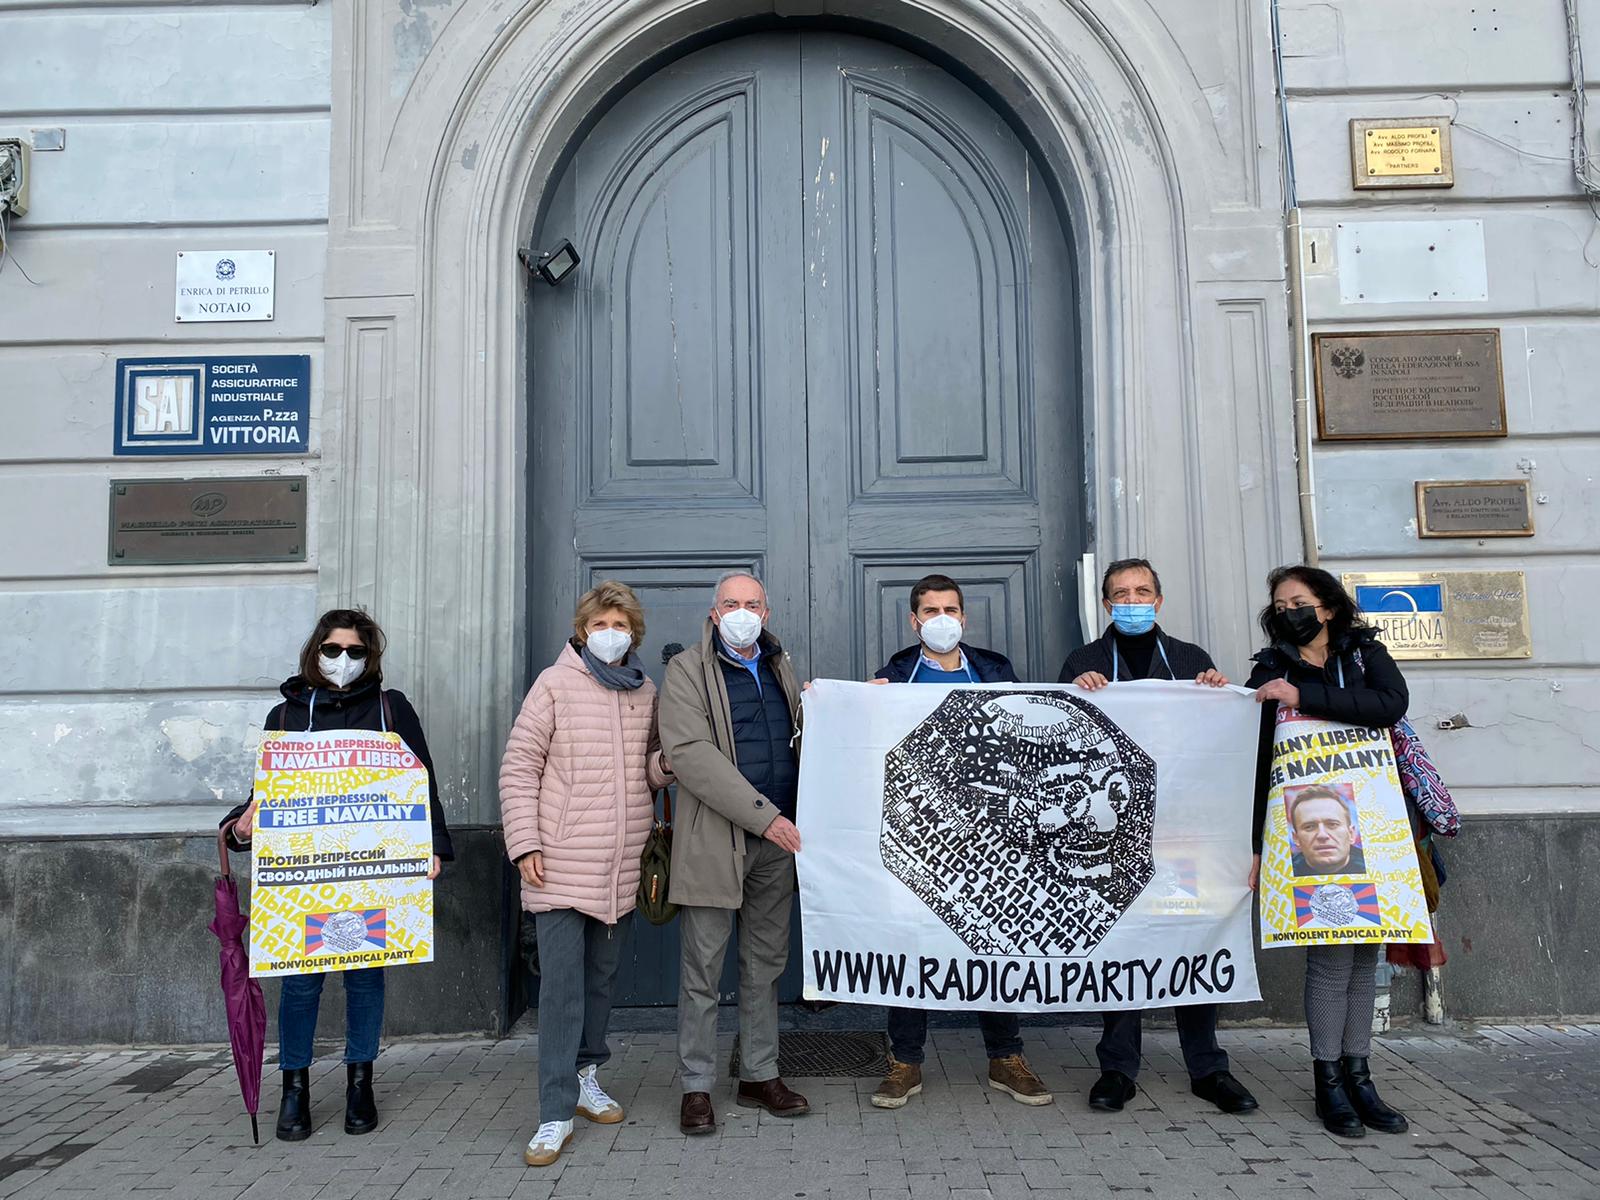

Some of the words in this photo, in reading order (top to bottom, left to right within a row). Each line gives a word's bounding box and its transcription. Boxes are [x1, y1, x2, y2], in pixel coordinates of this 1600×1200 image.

[1310, 240, 1316, 263] 1
[180, 287, 213, 296] ENRICA
[216, 286, 228, 296] DI
[229, 286, 270, 296] PETRILLO
[198, 302, 251, 315] NOTAIO
[212, 362, 258, 374] SOCIETÀ
[211, 377, 298, 389] ASSICURATRICE
[136, 376, 192, 433] SAI
[211, 392, 284, 402] INDUSTRIALE
[210, 414, 261, 423] AGENZIA
[263, 408, 298, 422] P.zza
[210, 425, 300, 444] VITTORIA
[264, 740, 314, 751] CONTRO
[317, 740, 332, 750] LA
[1318, 727, 1387, 747] LIBERO!
[271, 750, 353, 769] NAVALNY
[356, 751, 416, 768] LIBERO
[1286, 749, 1394, 780] NAVALNY!
[260, 796, 314, 808] AGAINST
[316, 793, 388, 806] REPRESSION
[272, 808, 318, 826] FREE
[324, 804, 414, 824] NAVALNY
[258, 854, 310, 866] ПРОТИВ
[313, 847, 386, 865] РЕПРЕССИЙ
[258, 865, 346, 882] СВОБОДНЫЙ
[348, 860, 428, 877] НАВАЛЬНЫЙ
[957, 798, 1021, 864] PARTITO
[1022, 862, 1107, 940] RADICALE
[908, 813, 980, 884] PARTIDO
[980, 882, 1049, 956] RADICAL
[968, 829, 1039, 902] RADICAL
[1041, 896, 1097, 950] PARTY
[905, 834, 960, 886] PARTI
[959, 882, 1030, 955] RADICAL
[1272, 930, 1330, 942] NONVIOLENT
[1332, 929, 1379, 940] RADICAL
[1380, 929, 1412, 938] PARTY
[270, 958, 336, 970] NONVIOLENT
[339, 953, 382, 964] RADICAL
[384, 950, 414, 960] PARTY
[812, 947, 1236, 1004] WWW.RADICALPARTY.ORG
